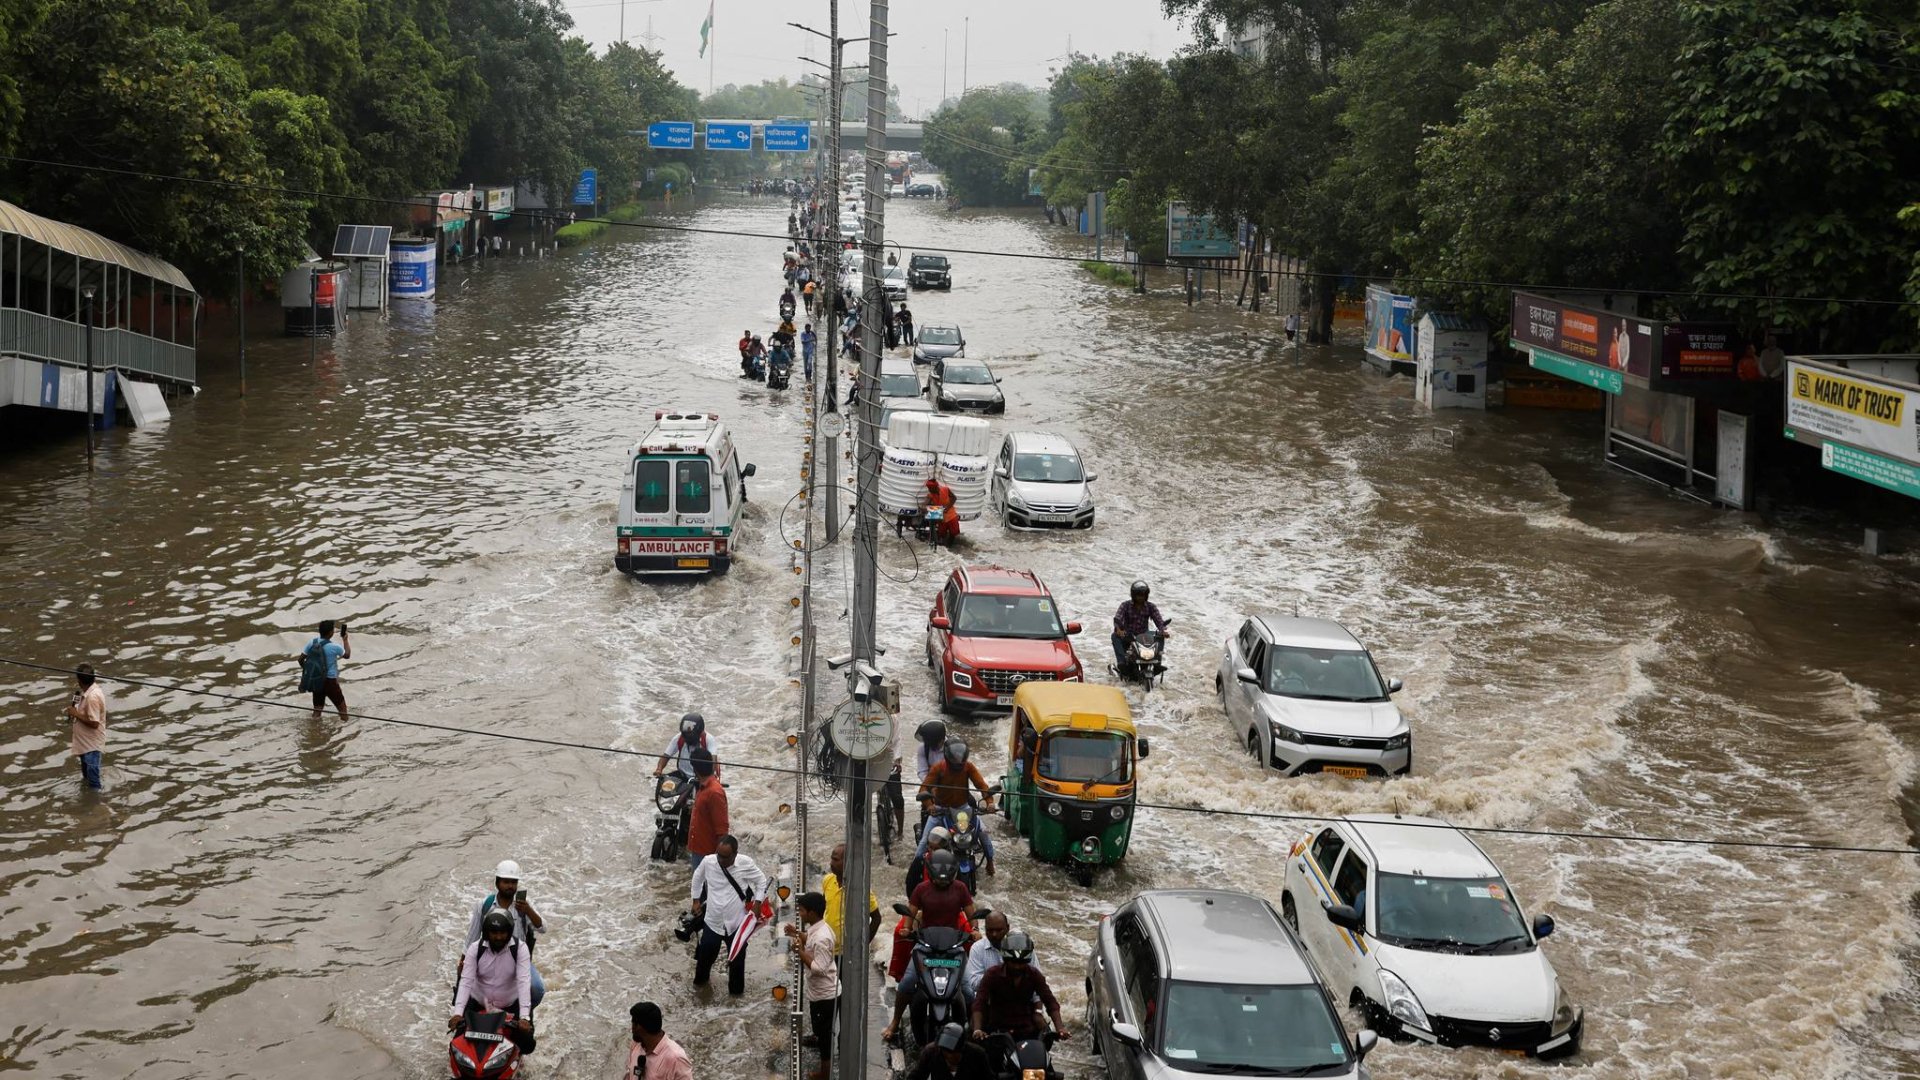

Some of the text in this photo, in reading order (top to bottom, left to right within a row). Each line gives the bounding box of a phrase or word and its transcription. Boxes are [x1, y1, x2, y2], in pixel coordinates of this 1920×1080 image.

[667, 136, 690, 144] Rajghat
[1814, 378, 1846, 407] MARK
[1847, 386, 1863, 411] OF
[1863, 391, 1901, 421] TRUST
[889, 457, 915, 467] PLASTO
[942, 461, 969, 472] PLASTO
[638, 542, 710, 553] AMBULANCE
